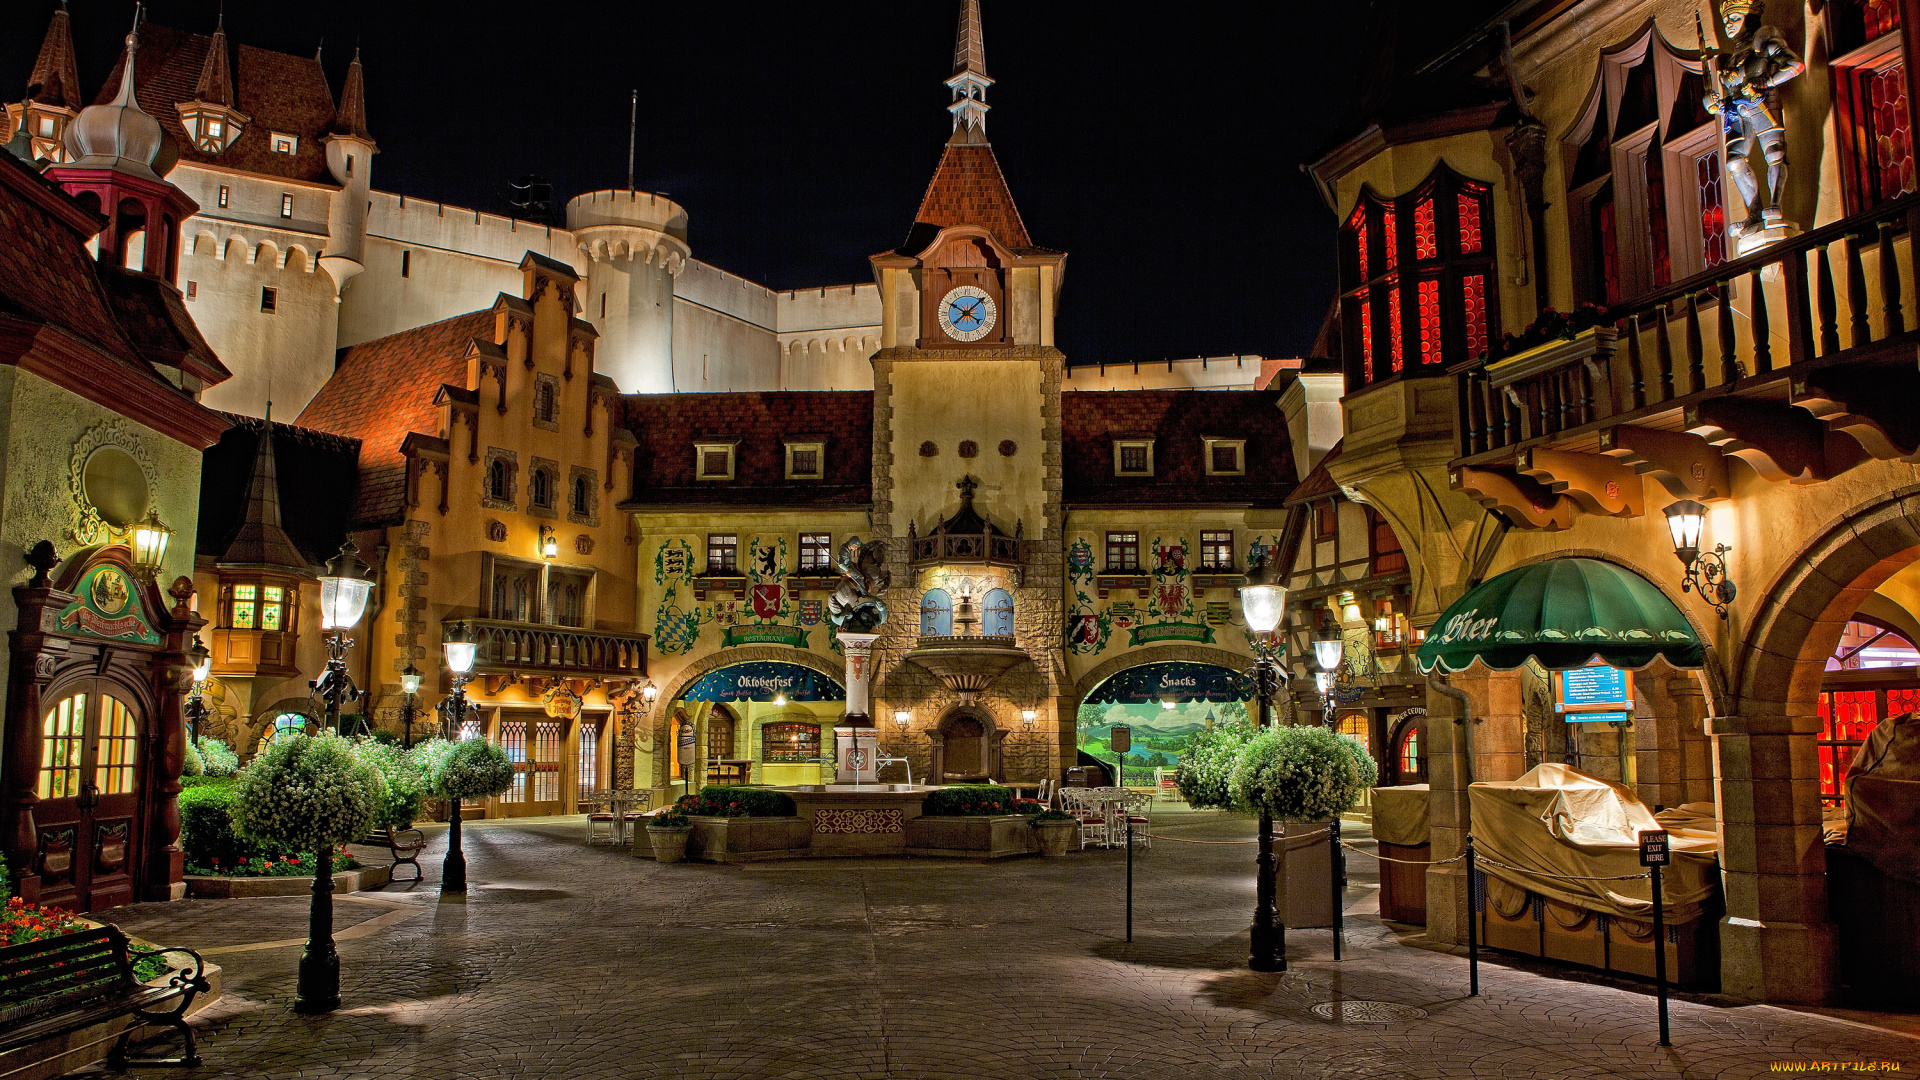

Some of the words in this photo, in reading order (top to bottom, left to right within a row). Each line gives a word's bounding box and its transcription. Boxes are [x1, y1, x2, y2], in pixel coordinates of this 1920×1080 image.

[1440, 608, 1498, 644] Bier
[737, 675, 793, 692] Oktoberfest
[1159, 673, 1196, 688] Snacks
[1641, 835, 1667, 843] PLEASE
[1647, 844, 1662, 853] EXIT
[1646, 854, 1664, 862] HERE
